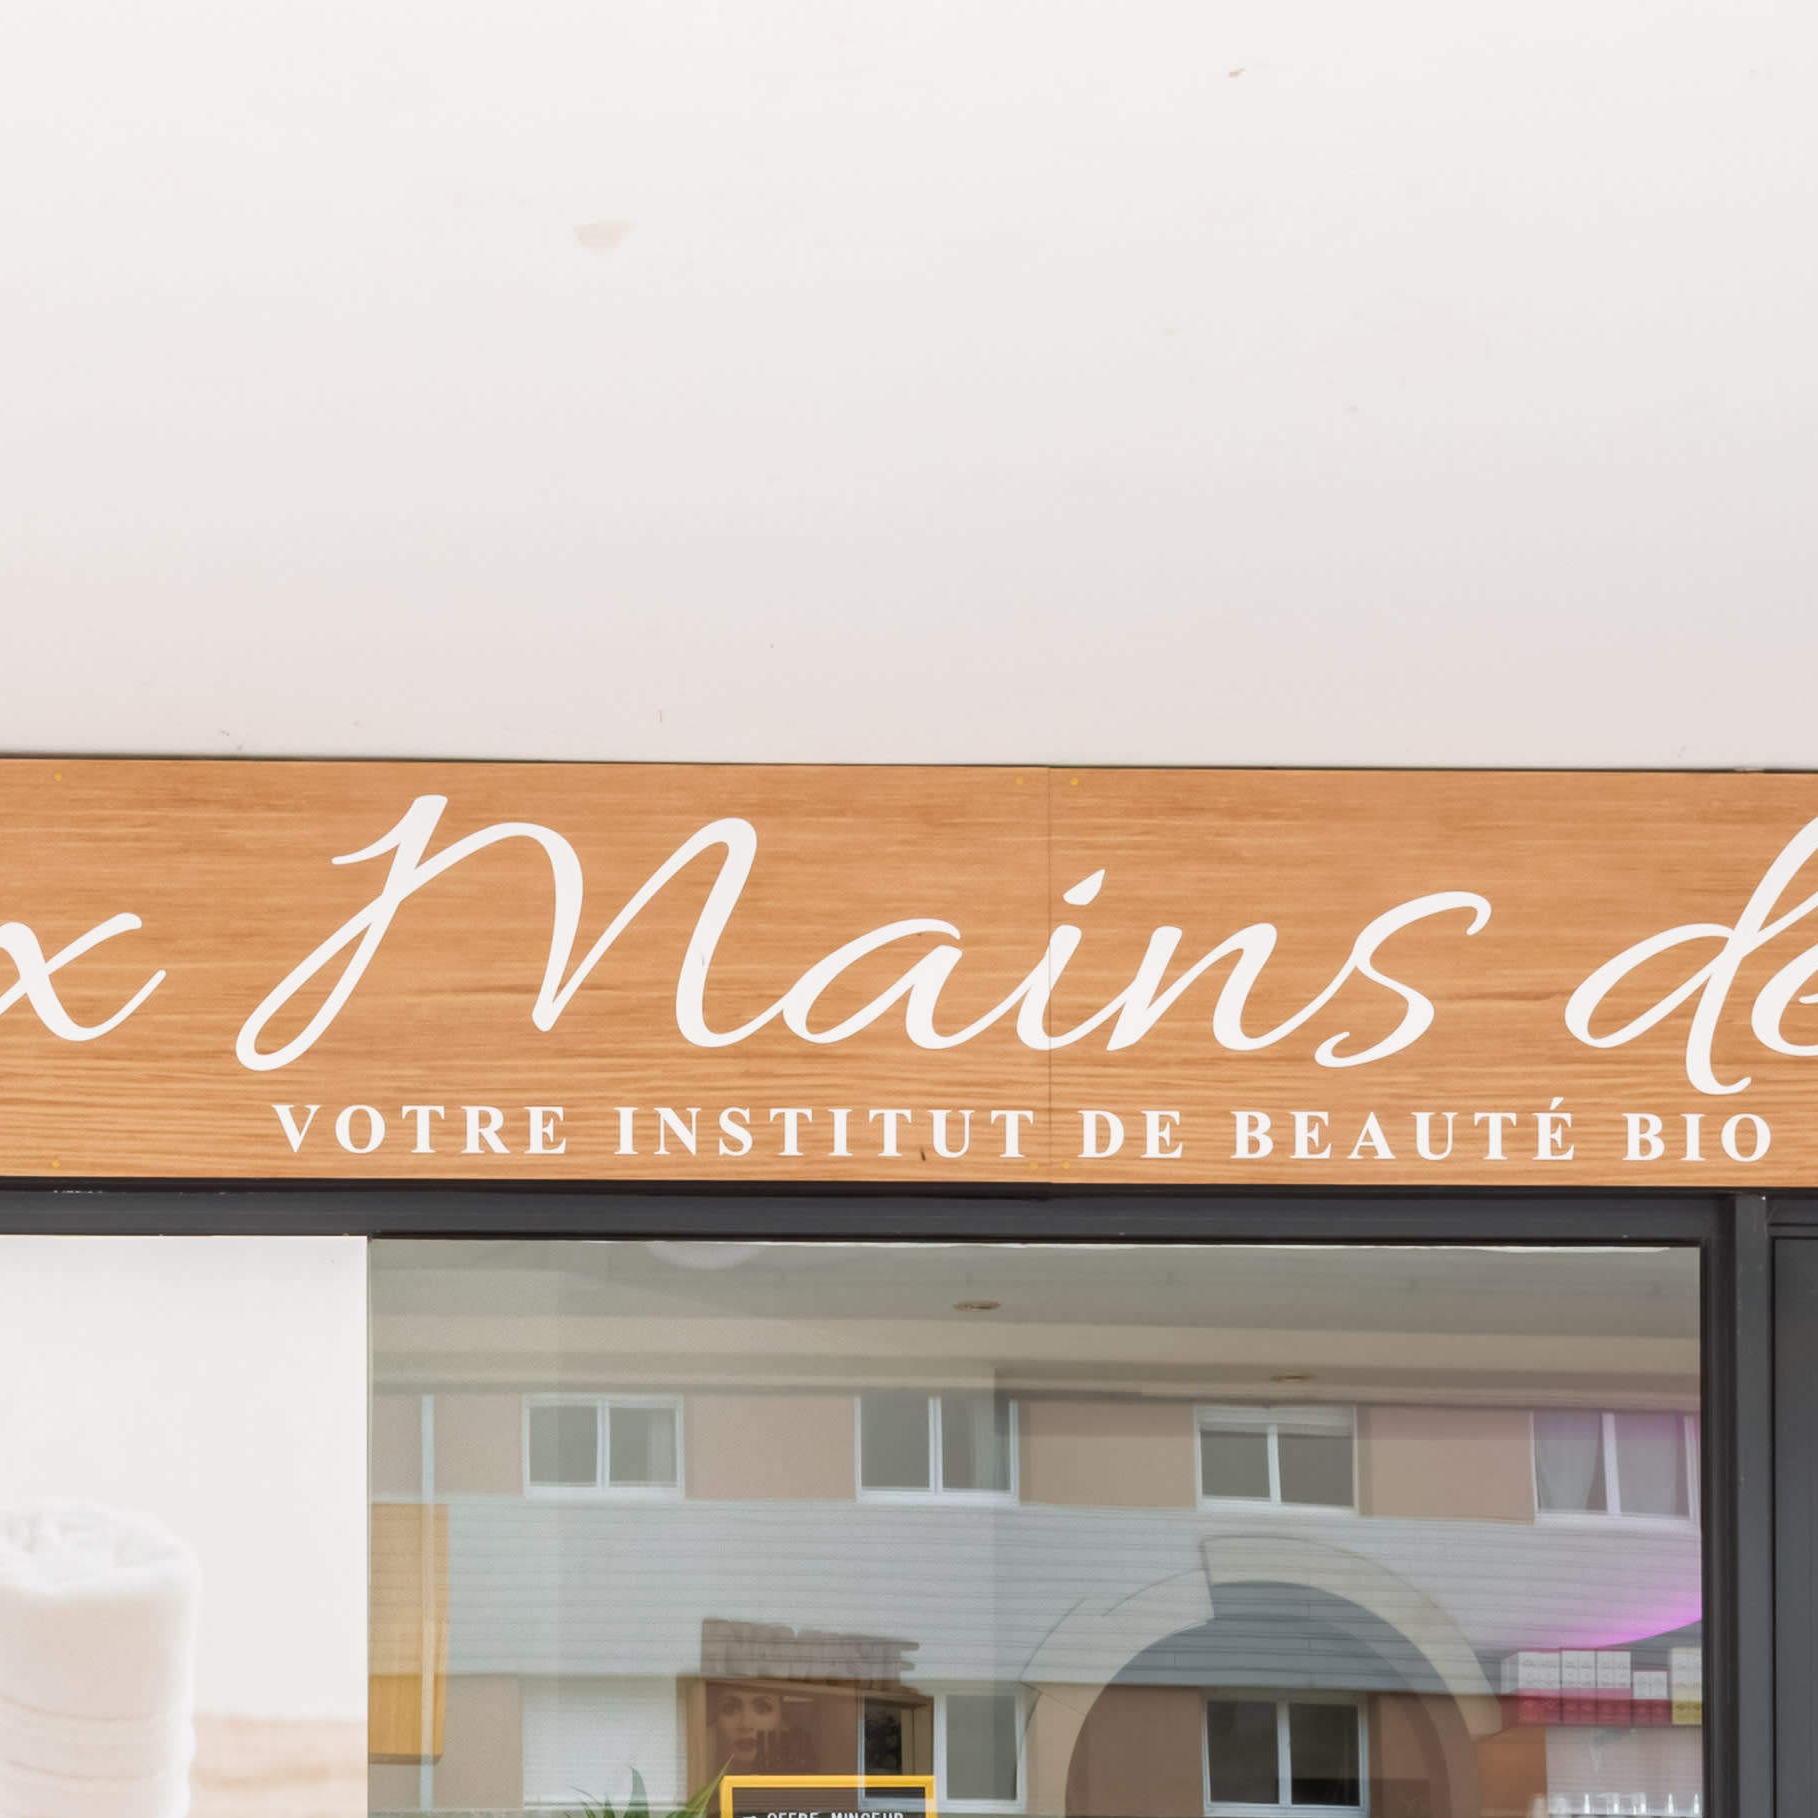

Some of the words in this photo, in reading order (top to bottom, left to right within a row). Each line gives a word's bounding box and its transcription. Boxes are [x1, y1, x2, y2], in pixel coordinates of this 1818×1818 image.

[234, 793, 1492, 1073] Mains
[271, 1103, 568, 1156] VOTRE
[614, 1106, 1037, 1160] INSTITUT
[1078, 1108, 1184, 1160] DE
[1232, 1097, 1576, 1162] BEAUTÉ
[1622, 1110, 1774, 1163] BIO
